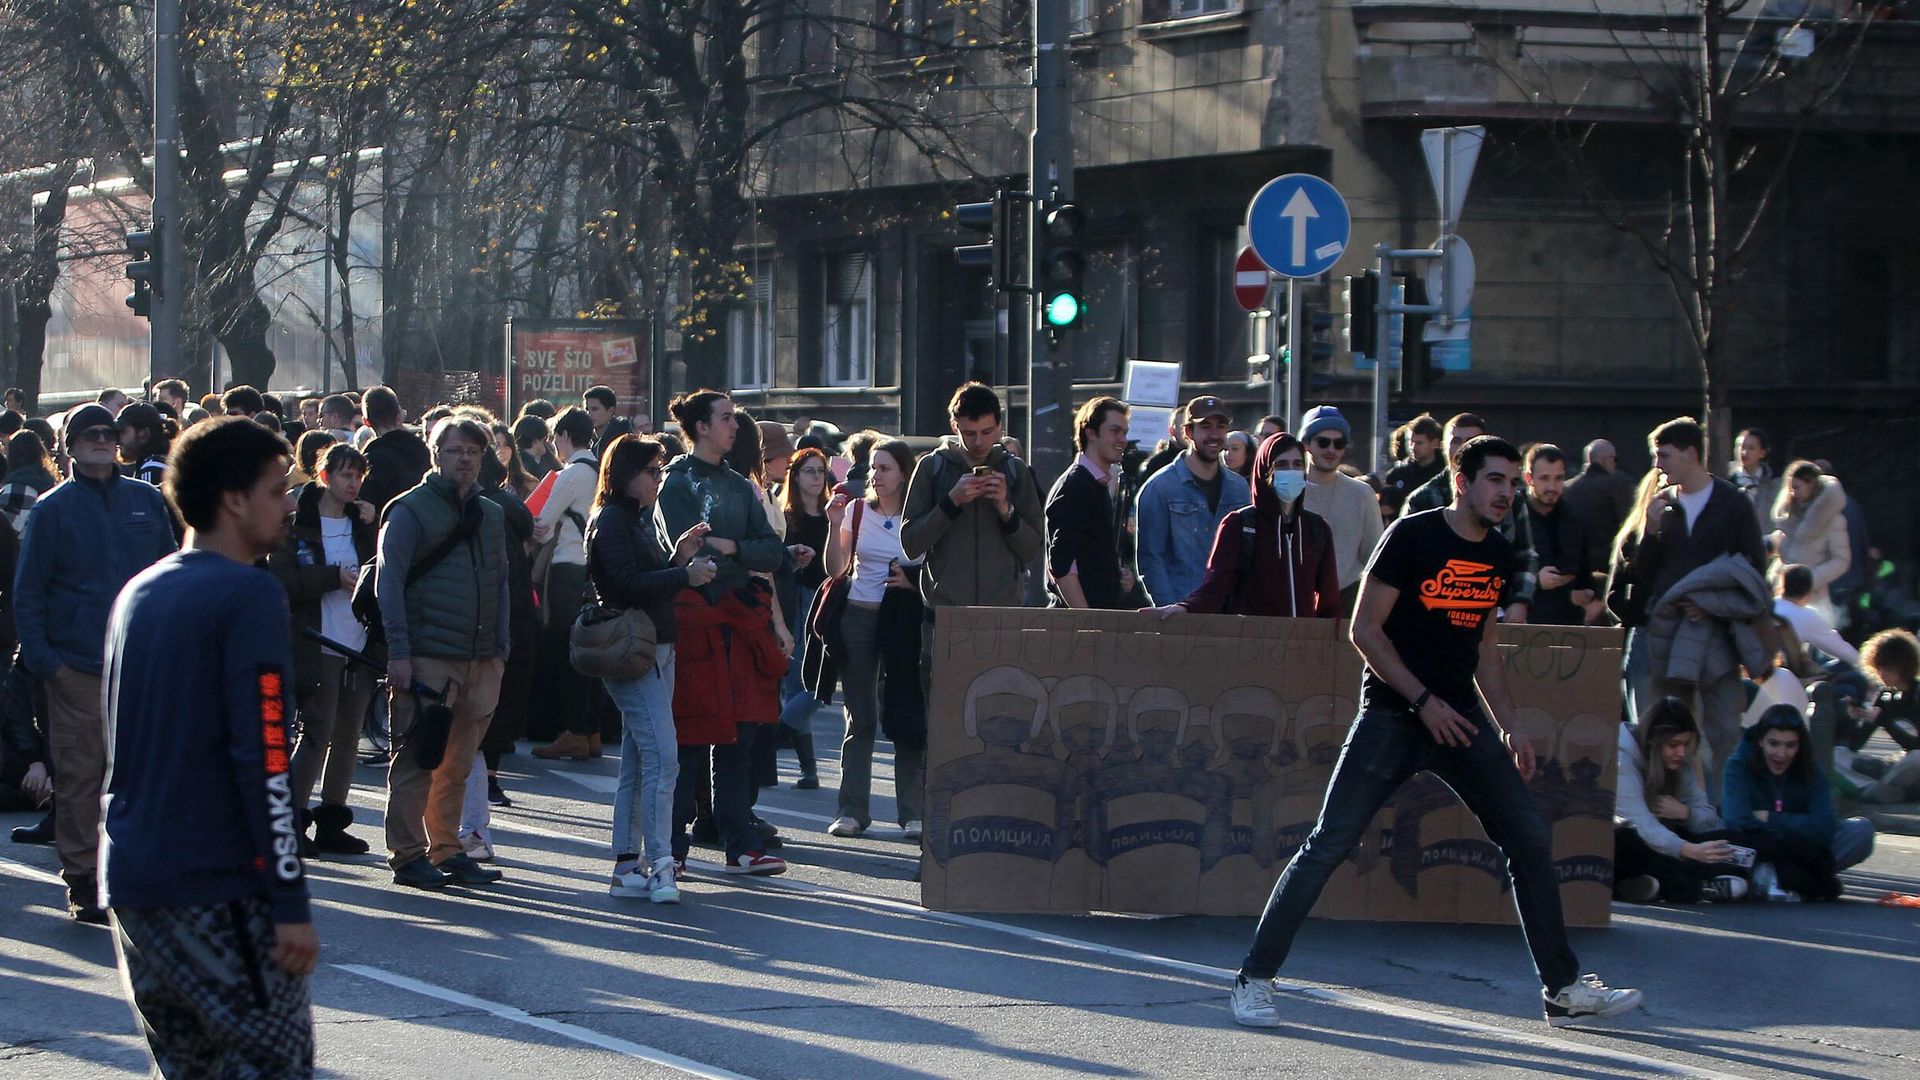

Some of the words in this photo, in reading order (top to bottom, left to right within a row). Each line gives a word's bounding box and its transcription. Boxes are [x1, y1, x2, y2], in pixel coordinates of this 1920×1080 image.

[527, 351, 557, 369] SVE
[563, 346, 592, 369] ŠTO
[522, 369, 595, 392] POŽELITE
[265, 772, 301, 881] OSAKA
